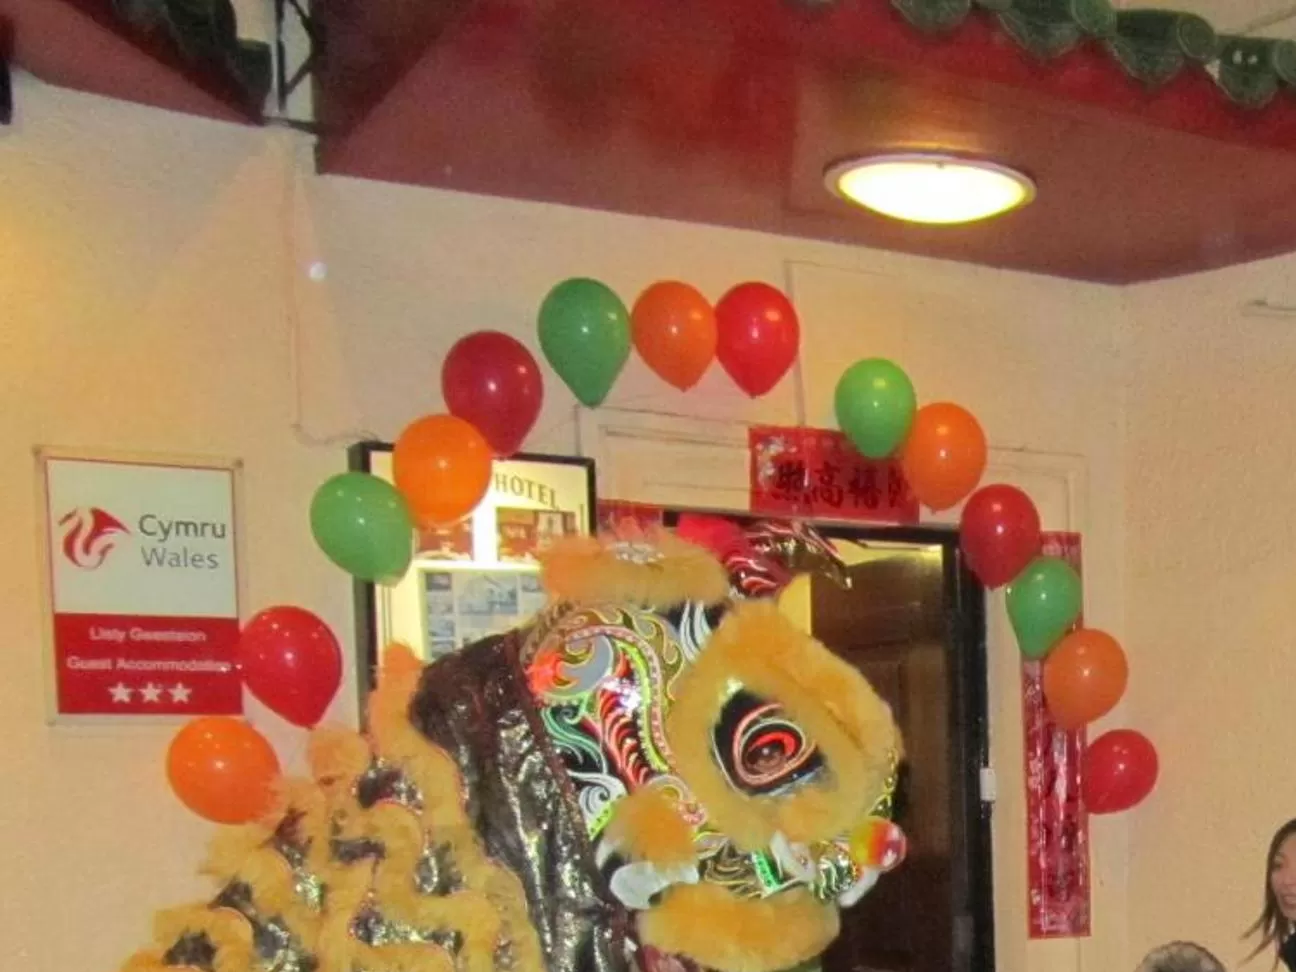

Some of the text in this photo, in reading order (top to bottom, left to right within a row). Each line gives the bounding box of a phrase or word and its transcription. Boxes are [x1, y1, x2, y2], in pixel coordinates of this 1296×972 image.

[495, 472, 560, 511] HOTEL
[138, 514, 227, 542] Cymru
[140, 547, 219, 569] Wales
